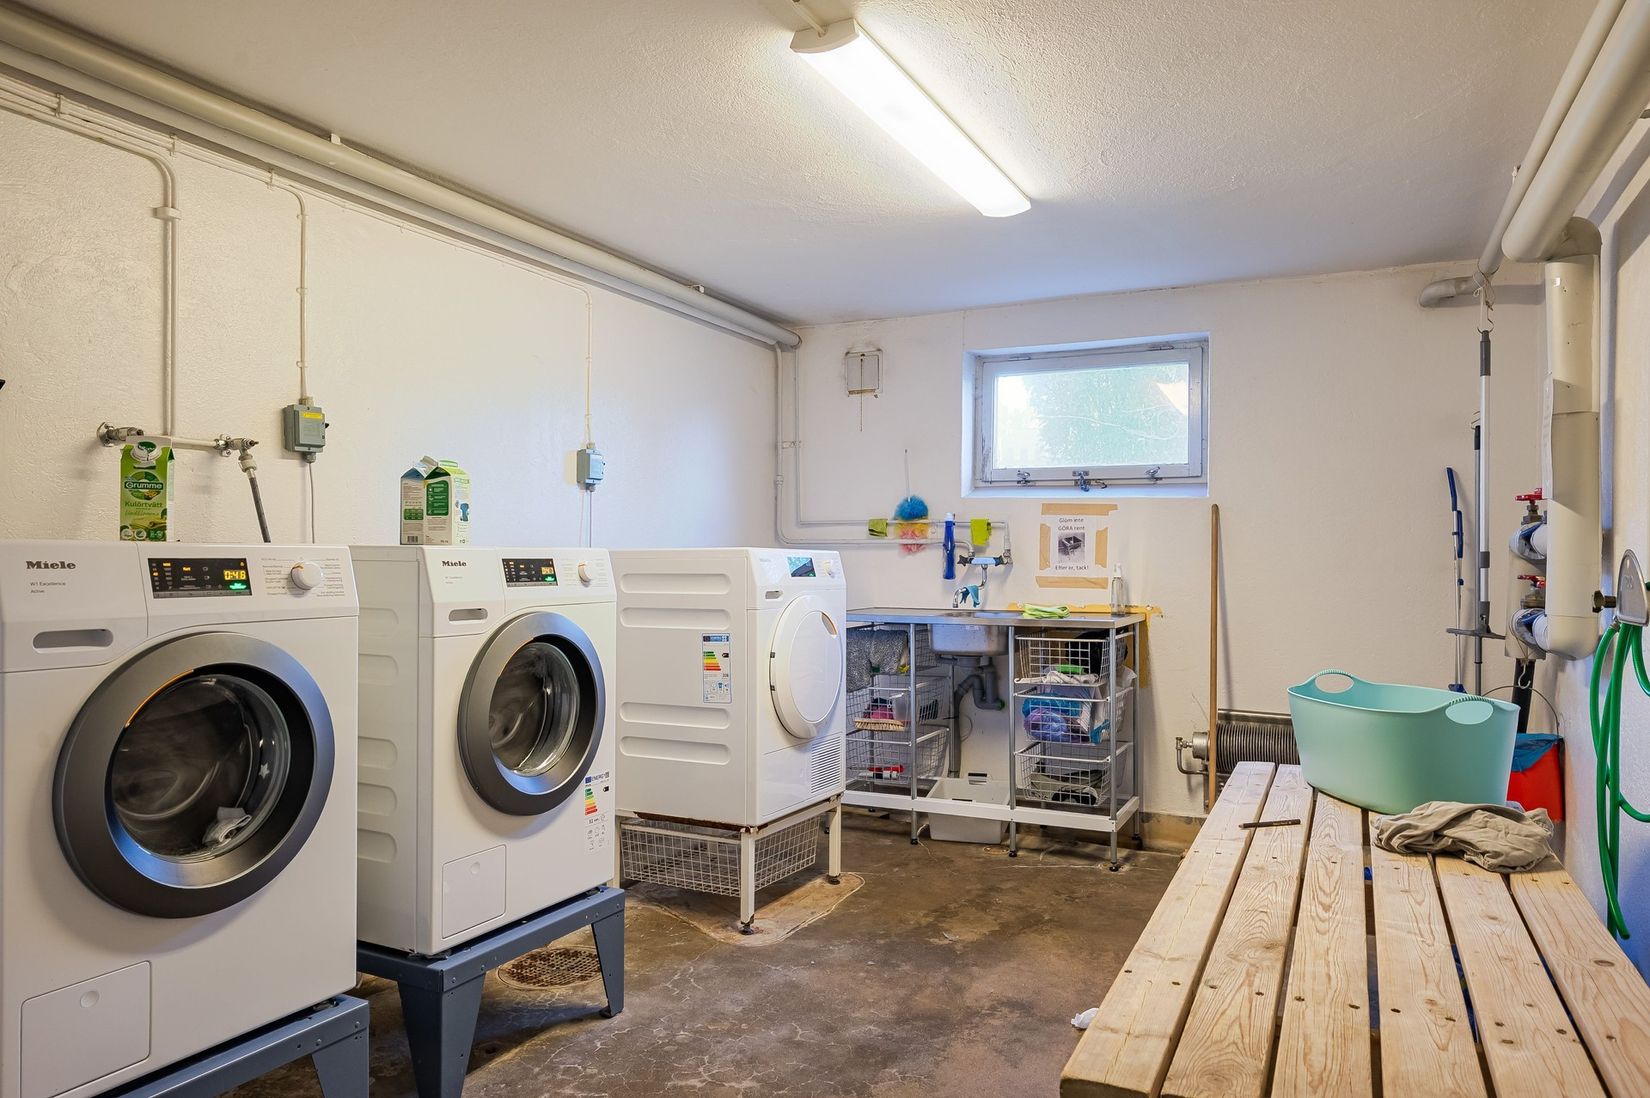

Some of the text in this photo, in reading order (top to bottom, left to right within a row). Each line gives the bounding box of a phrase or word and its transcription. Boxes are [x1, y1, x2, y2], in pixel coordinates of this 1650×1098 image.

[125, 482, 162, 490] Grumme
[124, 500, 163, 508] Kulörtvätt
[26, 560, 76, 570] Miele
